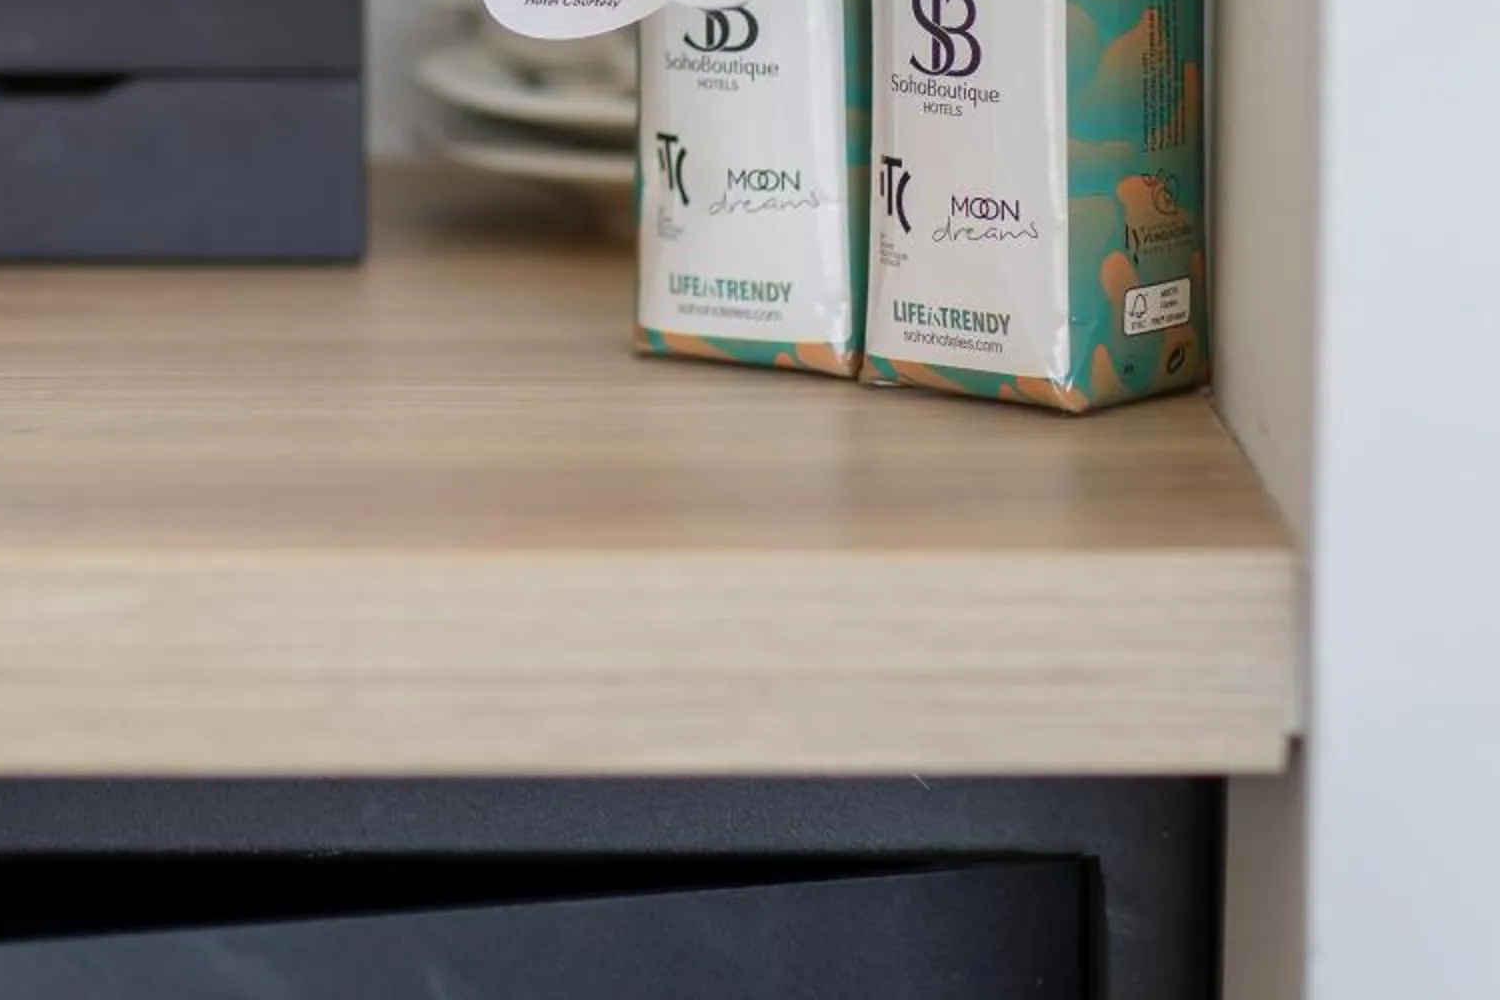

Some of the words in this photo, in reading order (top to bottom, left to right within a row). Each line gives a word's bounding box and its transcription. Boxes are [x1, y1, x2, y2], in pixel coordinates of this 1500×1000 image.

[664, 52, 780, 82] SohoBoutique
[696, 78, 740, 93] HOTELS
[890, 72, 1001, 109] SohoBoutique
[922, 101, 964, 118] HOTELS
[726, 167, 802, 192] MOON
[708, 191, 821, 217] dreams
[950, 194, 1021, 222] MOON
[931, 214, 1039, 244] dreams
